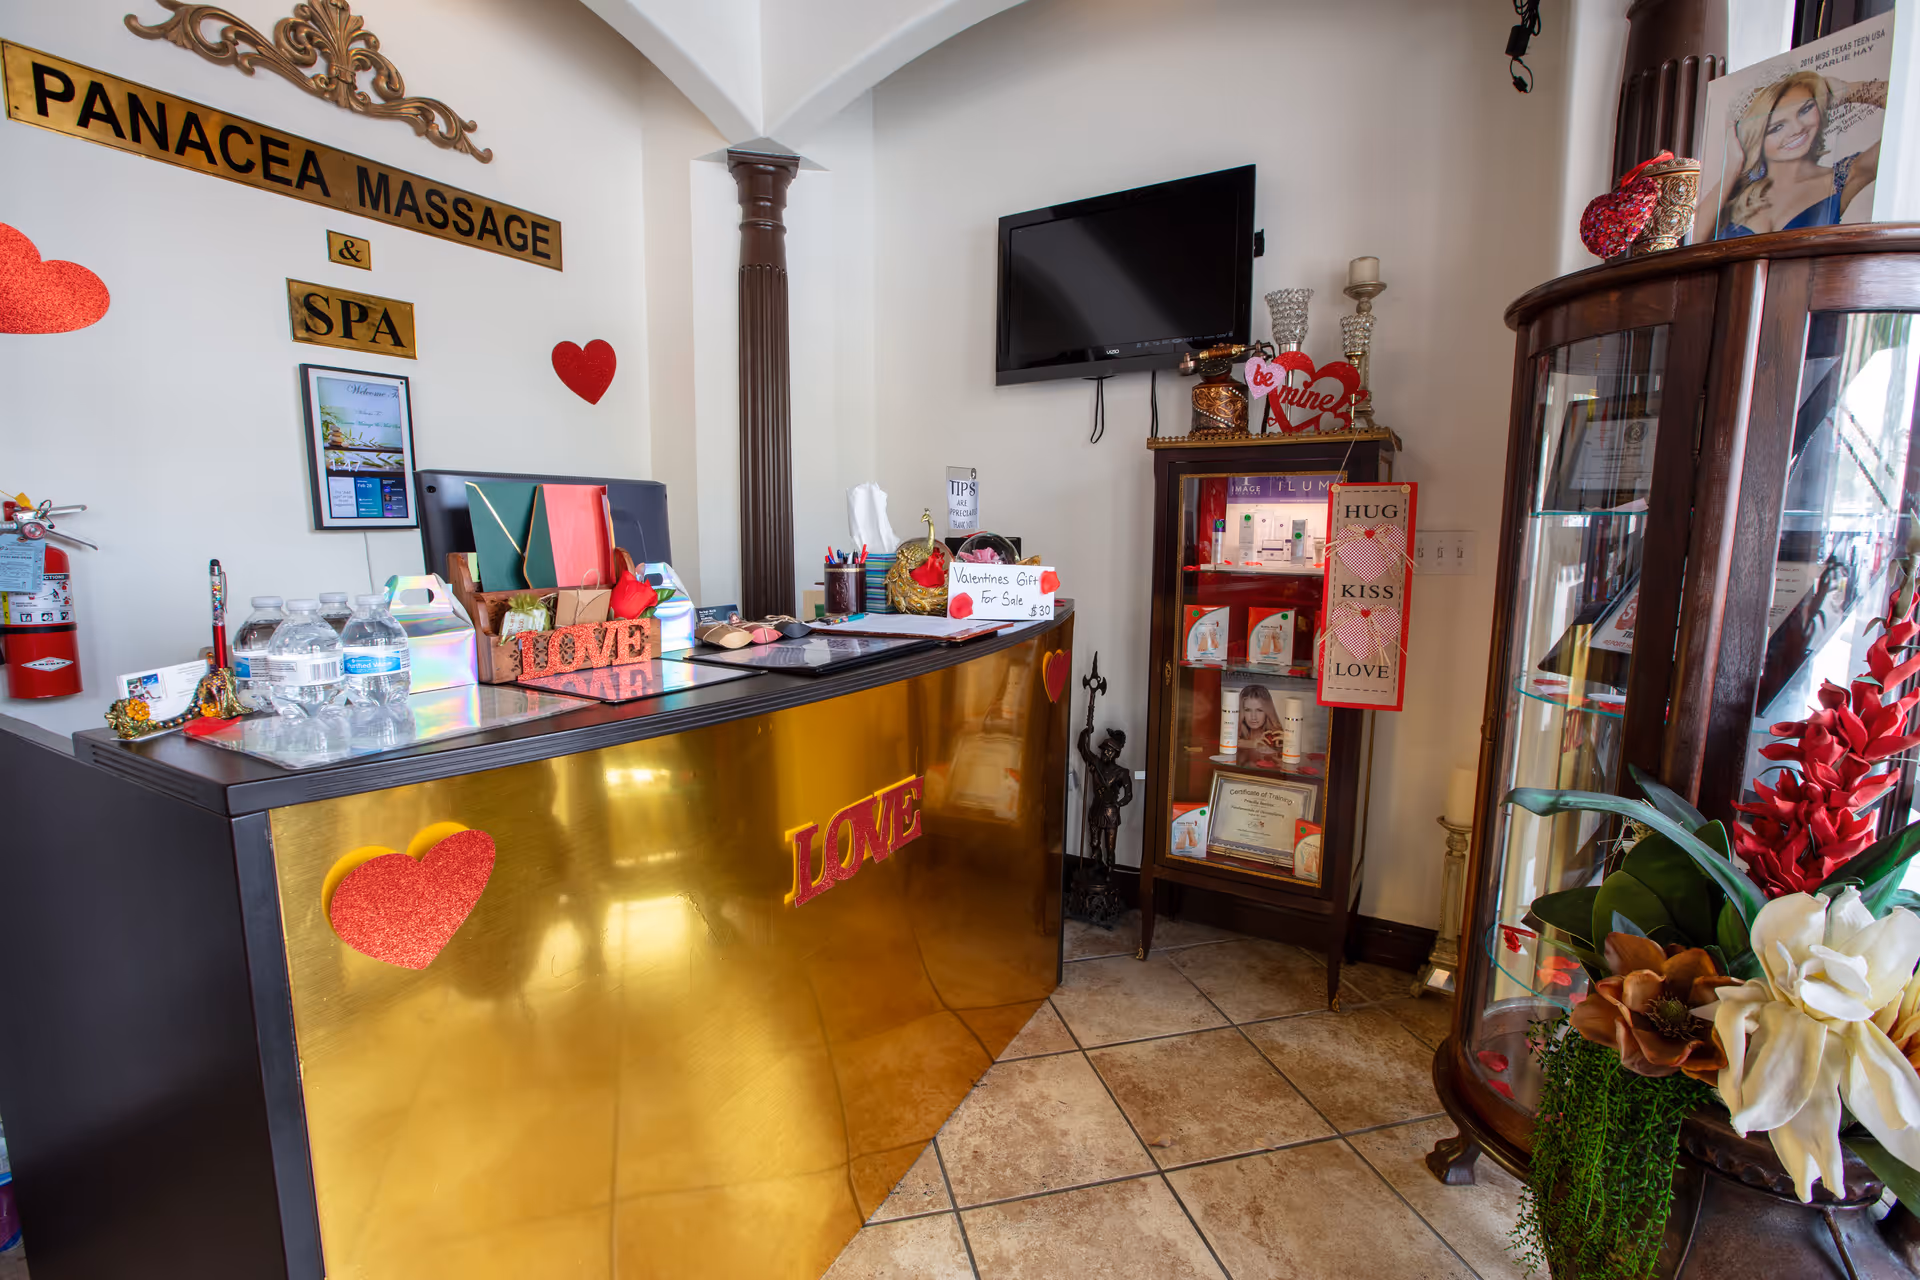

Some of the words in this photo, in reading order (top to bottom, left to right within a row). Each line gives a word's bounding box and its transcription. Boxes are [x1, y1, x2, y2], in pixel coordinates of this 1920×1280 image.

[1815, 49, 1830, 61] MISS
[1831, 42, 1852, 56] TEXAS
[1853, 36, 1870, 48] TEEN
[1871, 28, 1886, 41] USA
[1815, 53, 1850, 71] KARLIE
[1853, 45, 1874, 57] HAY
[32, 61, 331, 198] PANACEA
[356, 165, 551, 260] MASSAGE
[338, 239, 362, 263] &
[303, 292, 408, 349] SPA
[1253, 363, 1275, 388] be
[346, 384, 386, 398] Welcome
[1278, 381, 1335, 411] mine
[329, 459, 361, 472] 1:47
[949, 479, 976, 497] TIPS
[1232, 485, 1261, 493] IMAGE
[956, 499, 968, 507] ARE
[1344, 504, 1399, 519] HUG
[953, 566, 1010, 585] Valentines
[1016, 571, 1039, 587] Gift
[981, 589, 998, 604] For
[1002, 591, 1024, 607] Sale
[1341, 584, 1394, 599] KISS
[1028, 604, 1051, 618] $30
[515, 617, 652, 682] LOVE
[1336, 662, 1390, 679] LOVE
[1229, 788, 1260, 797] Certificate
[1260, 791, 1268, 799] of
[1268, 792, 1293, 806] Training
[794, 775, 925, 909] LOVE
